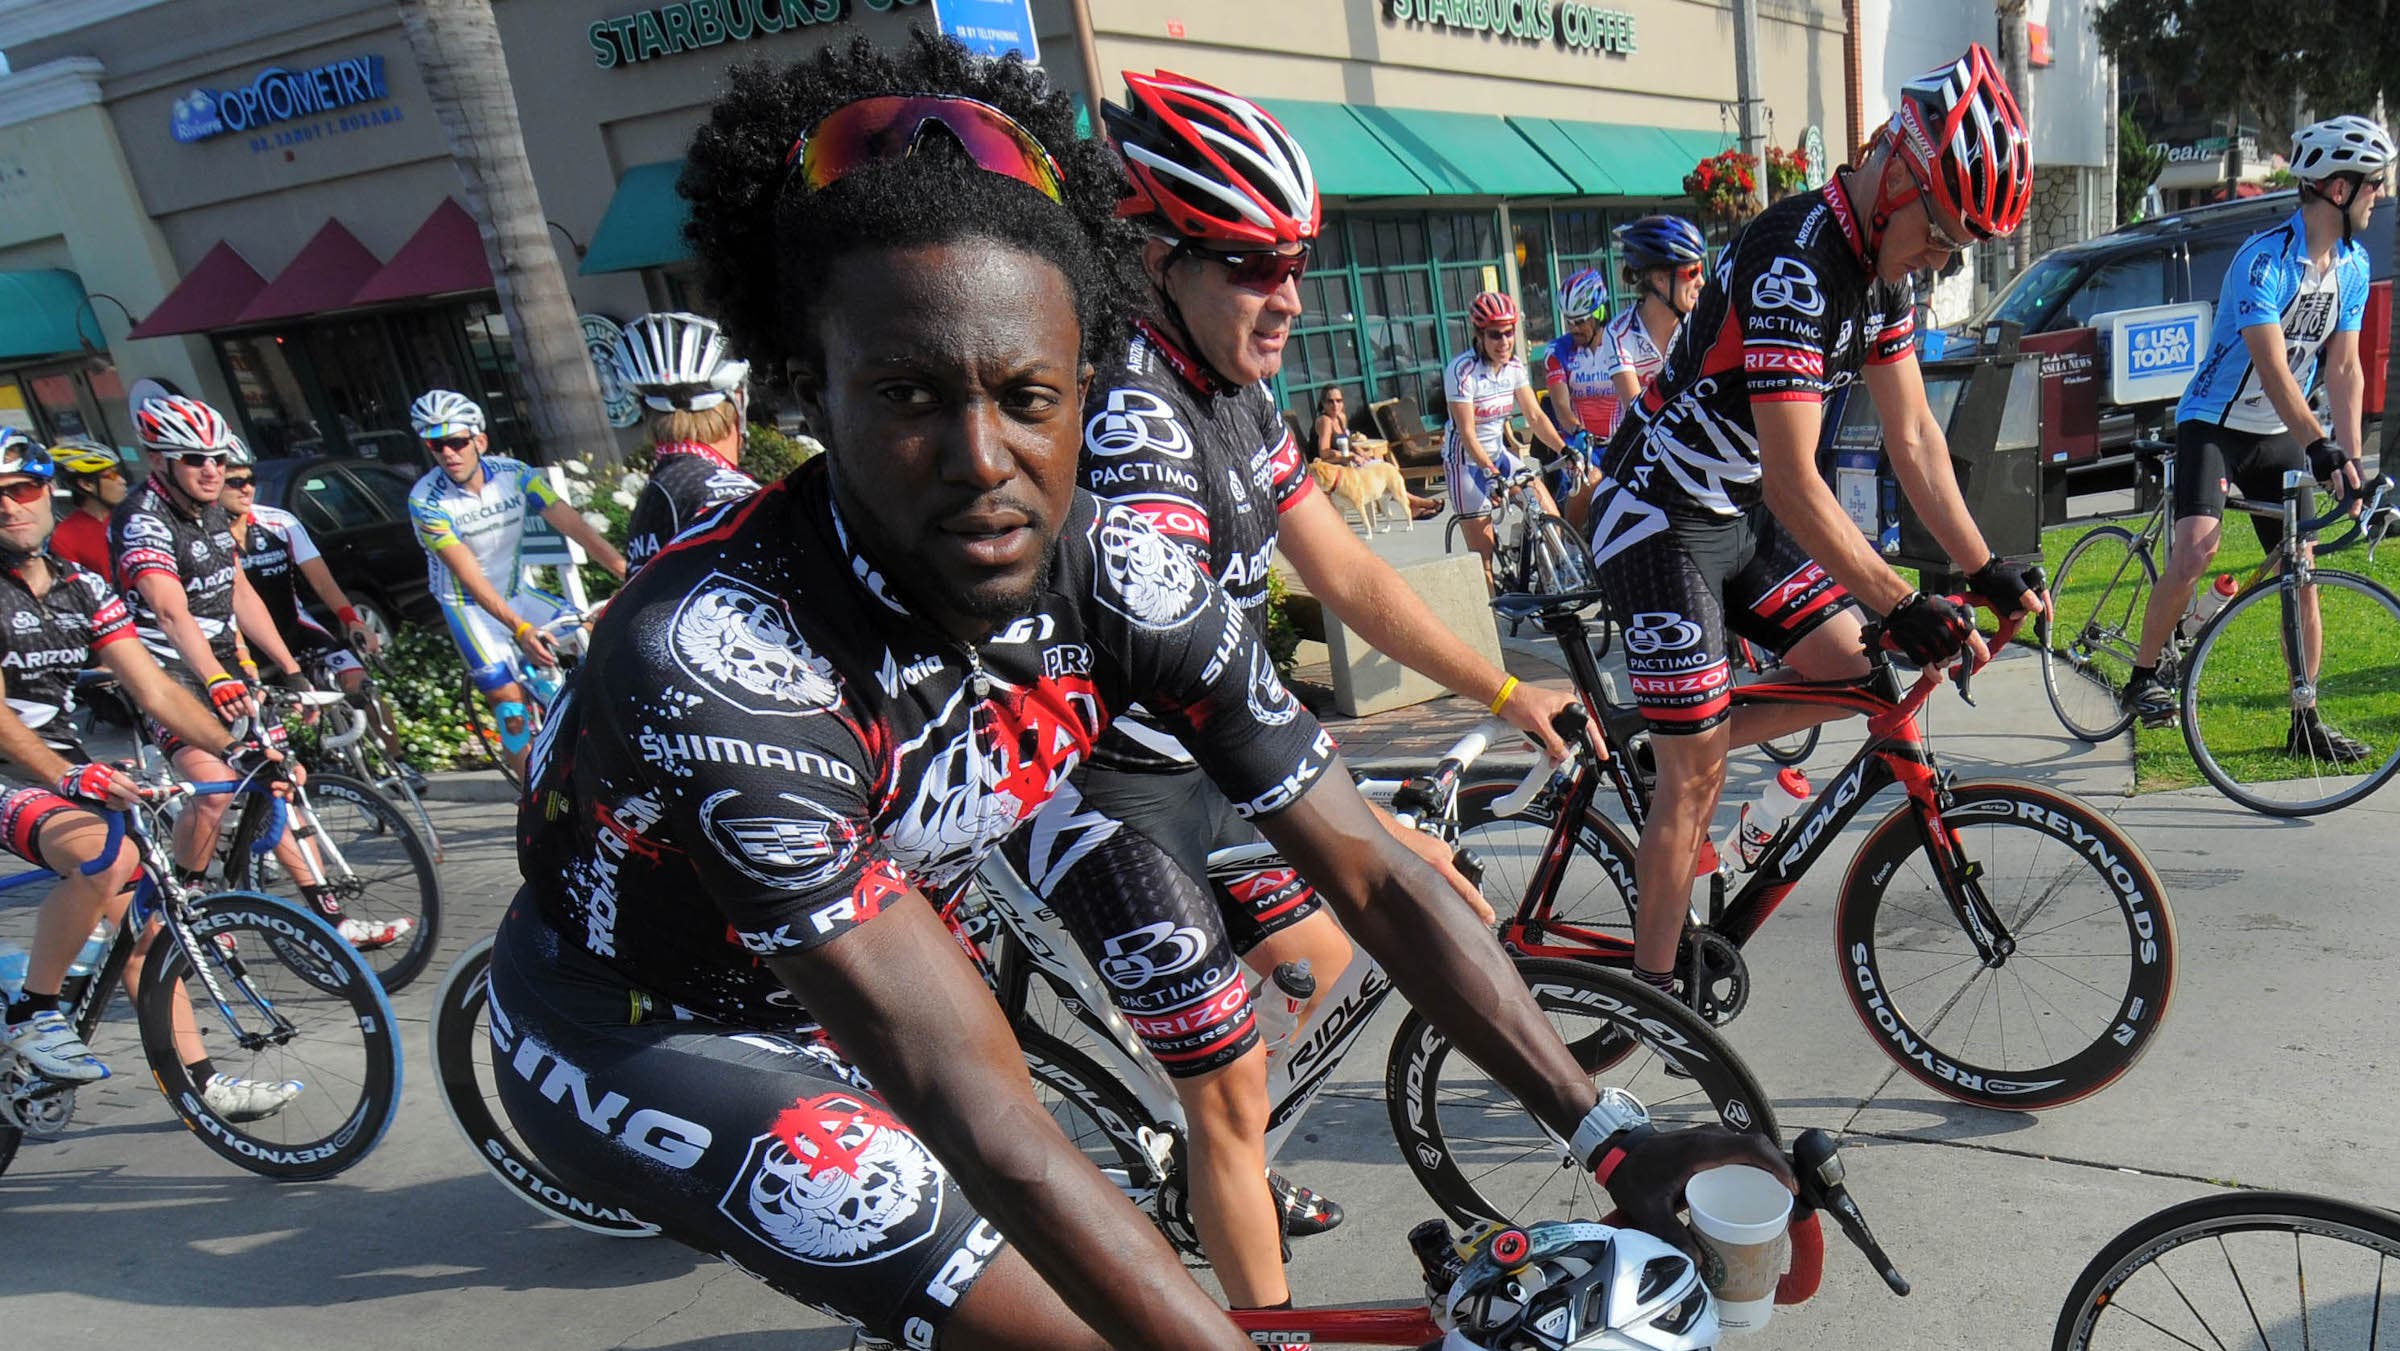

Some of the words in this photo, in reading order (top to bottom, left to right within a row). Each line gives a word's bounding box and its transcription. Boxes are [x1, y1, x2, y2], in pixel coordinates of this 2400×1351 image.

[1561, 2, 1638, 55] COFFEE
[220, 55, 377, 132] OPTOMETRY
[1901, 103, 1937, 159] SPECIALIZED
[1794, 203, 1827, 250] ARIZONA
[2131, 344, 2192, 369] TODAY
[2151, 326, 2189, 347] USA
[1090, 462, 1199, 493] PACTIMO
[1, 646, 89, 669] ARIZON
[1630, 652, 1707, 670] PACTIMO
[639, 730, 857, 787] SHIMANO
[1778, 757, 1865, 879] RIDLEY
[2015, 800, 2158, 966] REYNOLDS
[192, 911, 352, 985] REYNOLDS
[1119, 967, 1222, 1010] PACTIMO
[1850, 941, 1984, 1092] REYNOLDS
[1286, 967, 1390, 1083] RIDLE
[1530, 983, 1711, 1063] RIDLEY
[1405, 1023, 1447, 1139] RIDLE
[180, 1091, 340, 1165] REYNOLDS
